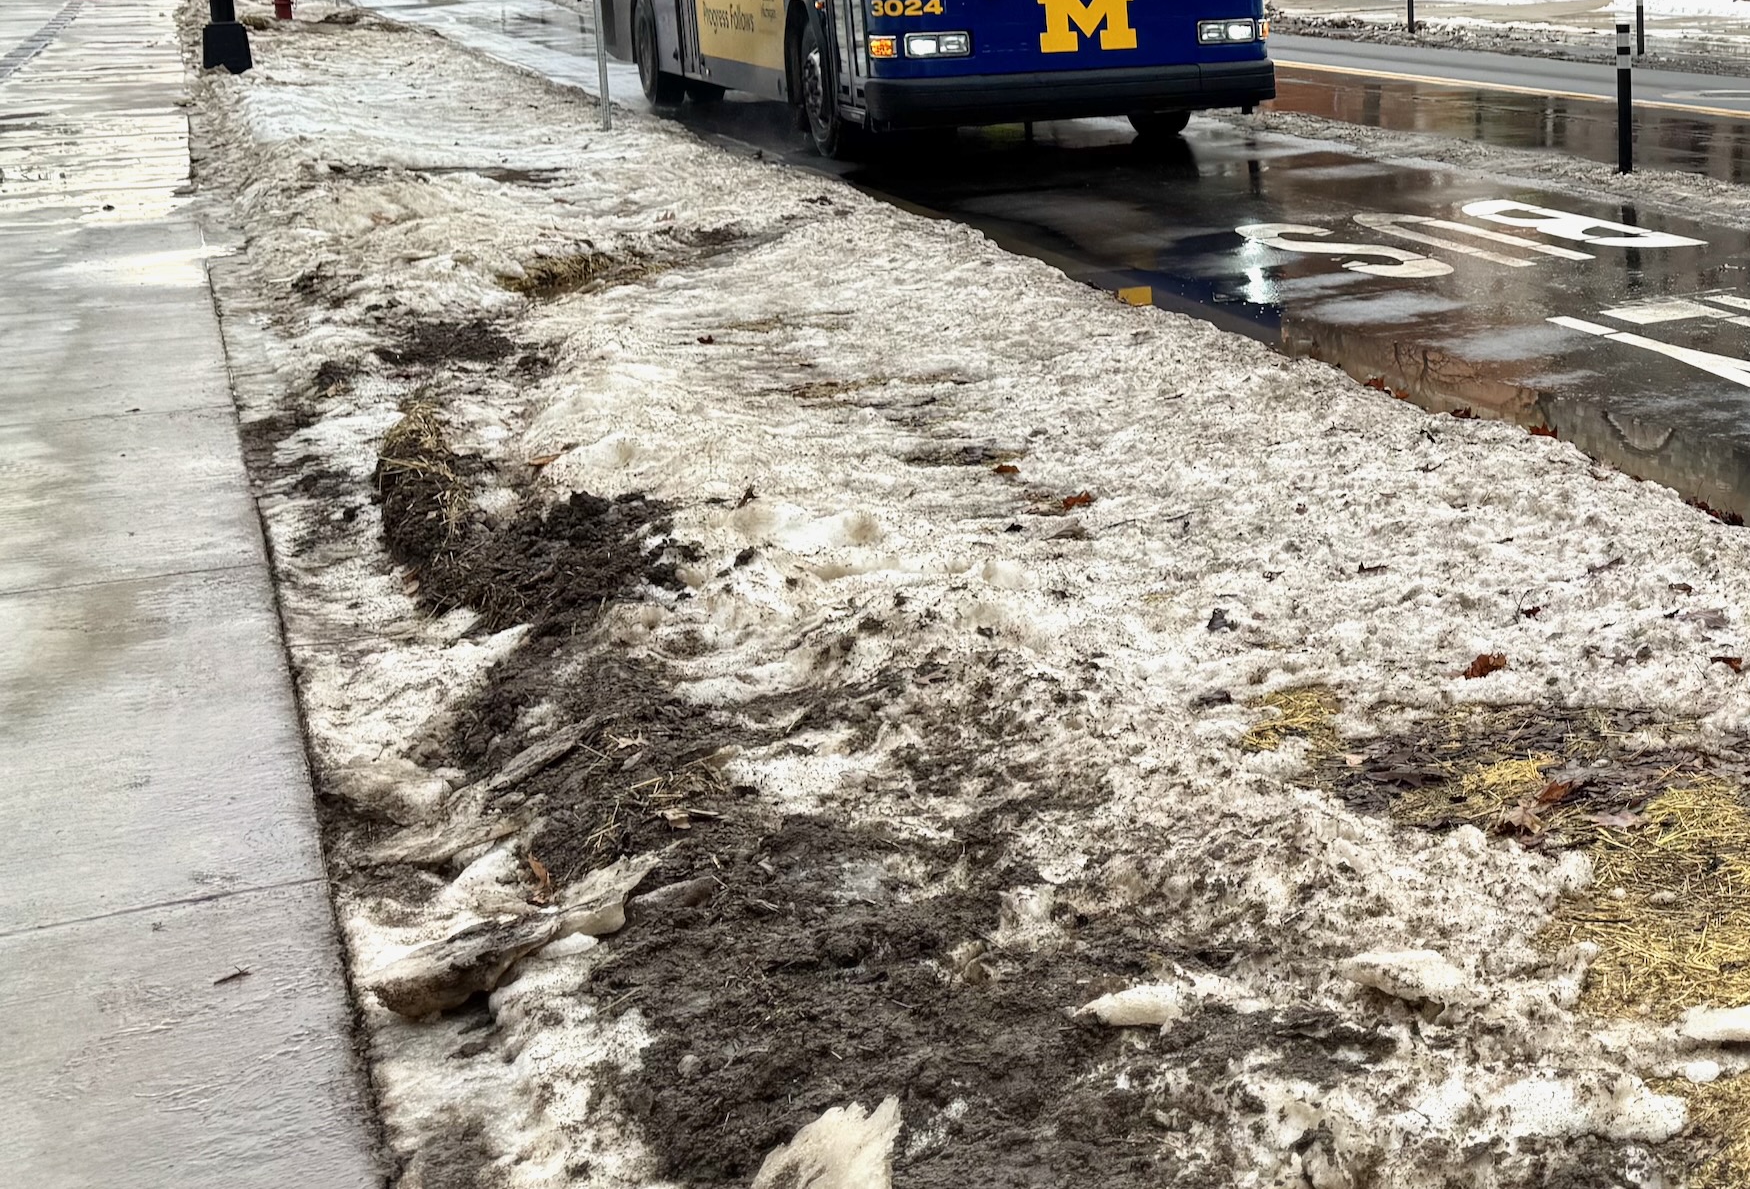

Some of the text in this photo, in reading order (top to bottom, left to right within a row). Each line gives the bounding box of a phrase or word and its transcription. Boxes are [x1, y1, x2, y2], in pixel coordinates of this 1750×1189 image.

[702, 0, 754, 35] Progress Follows
[1234, 199, 1709, 278] BUS
